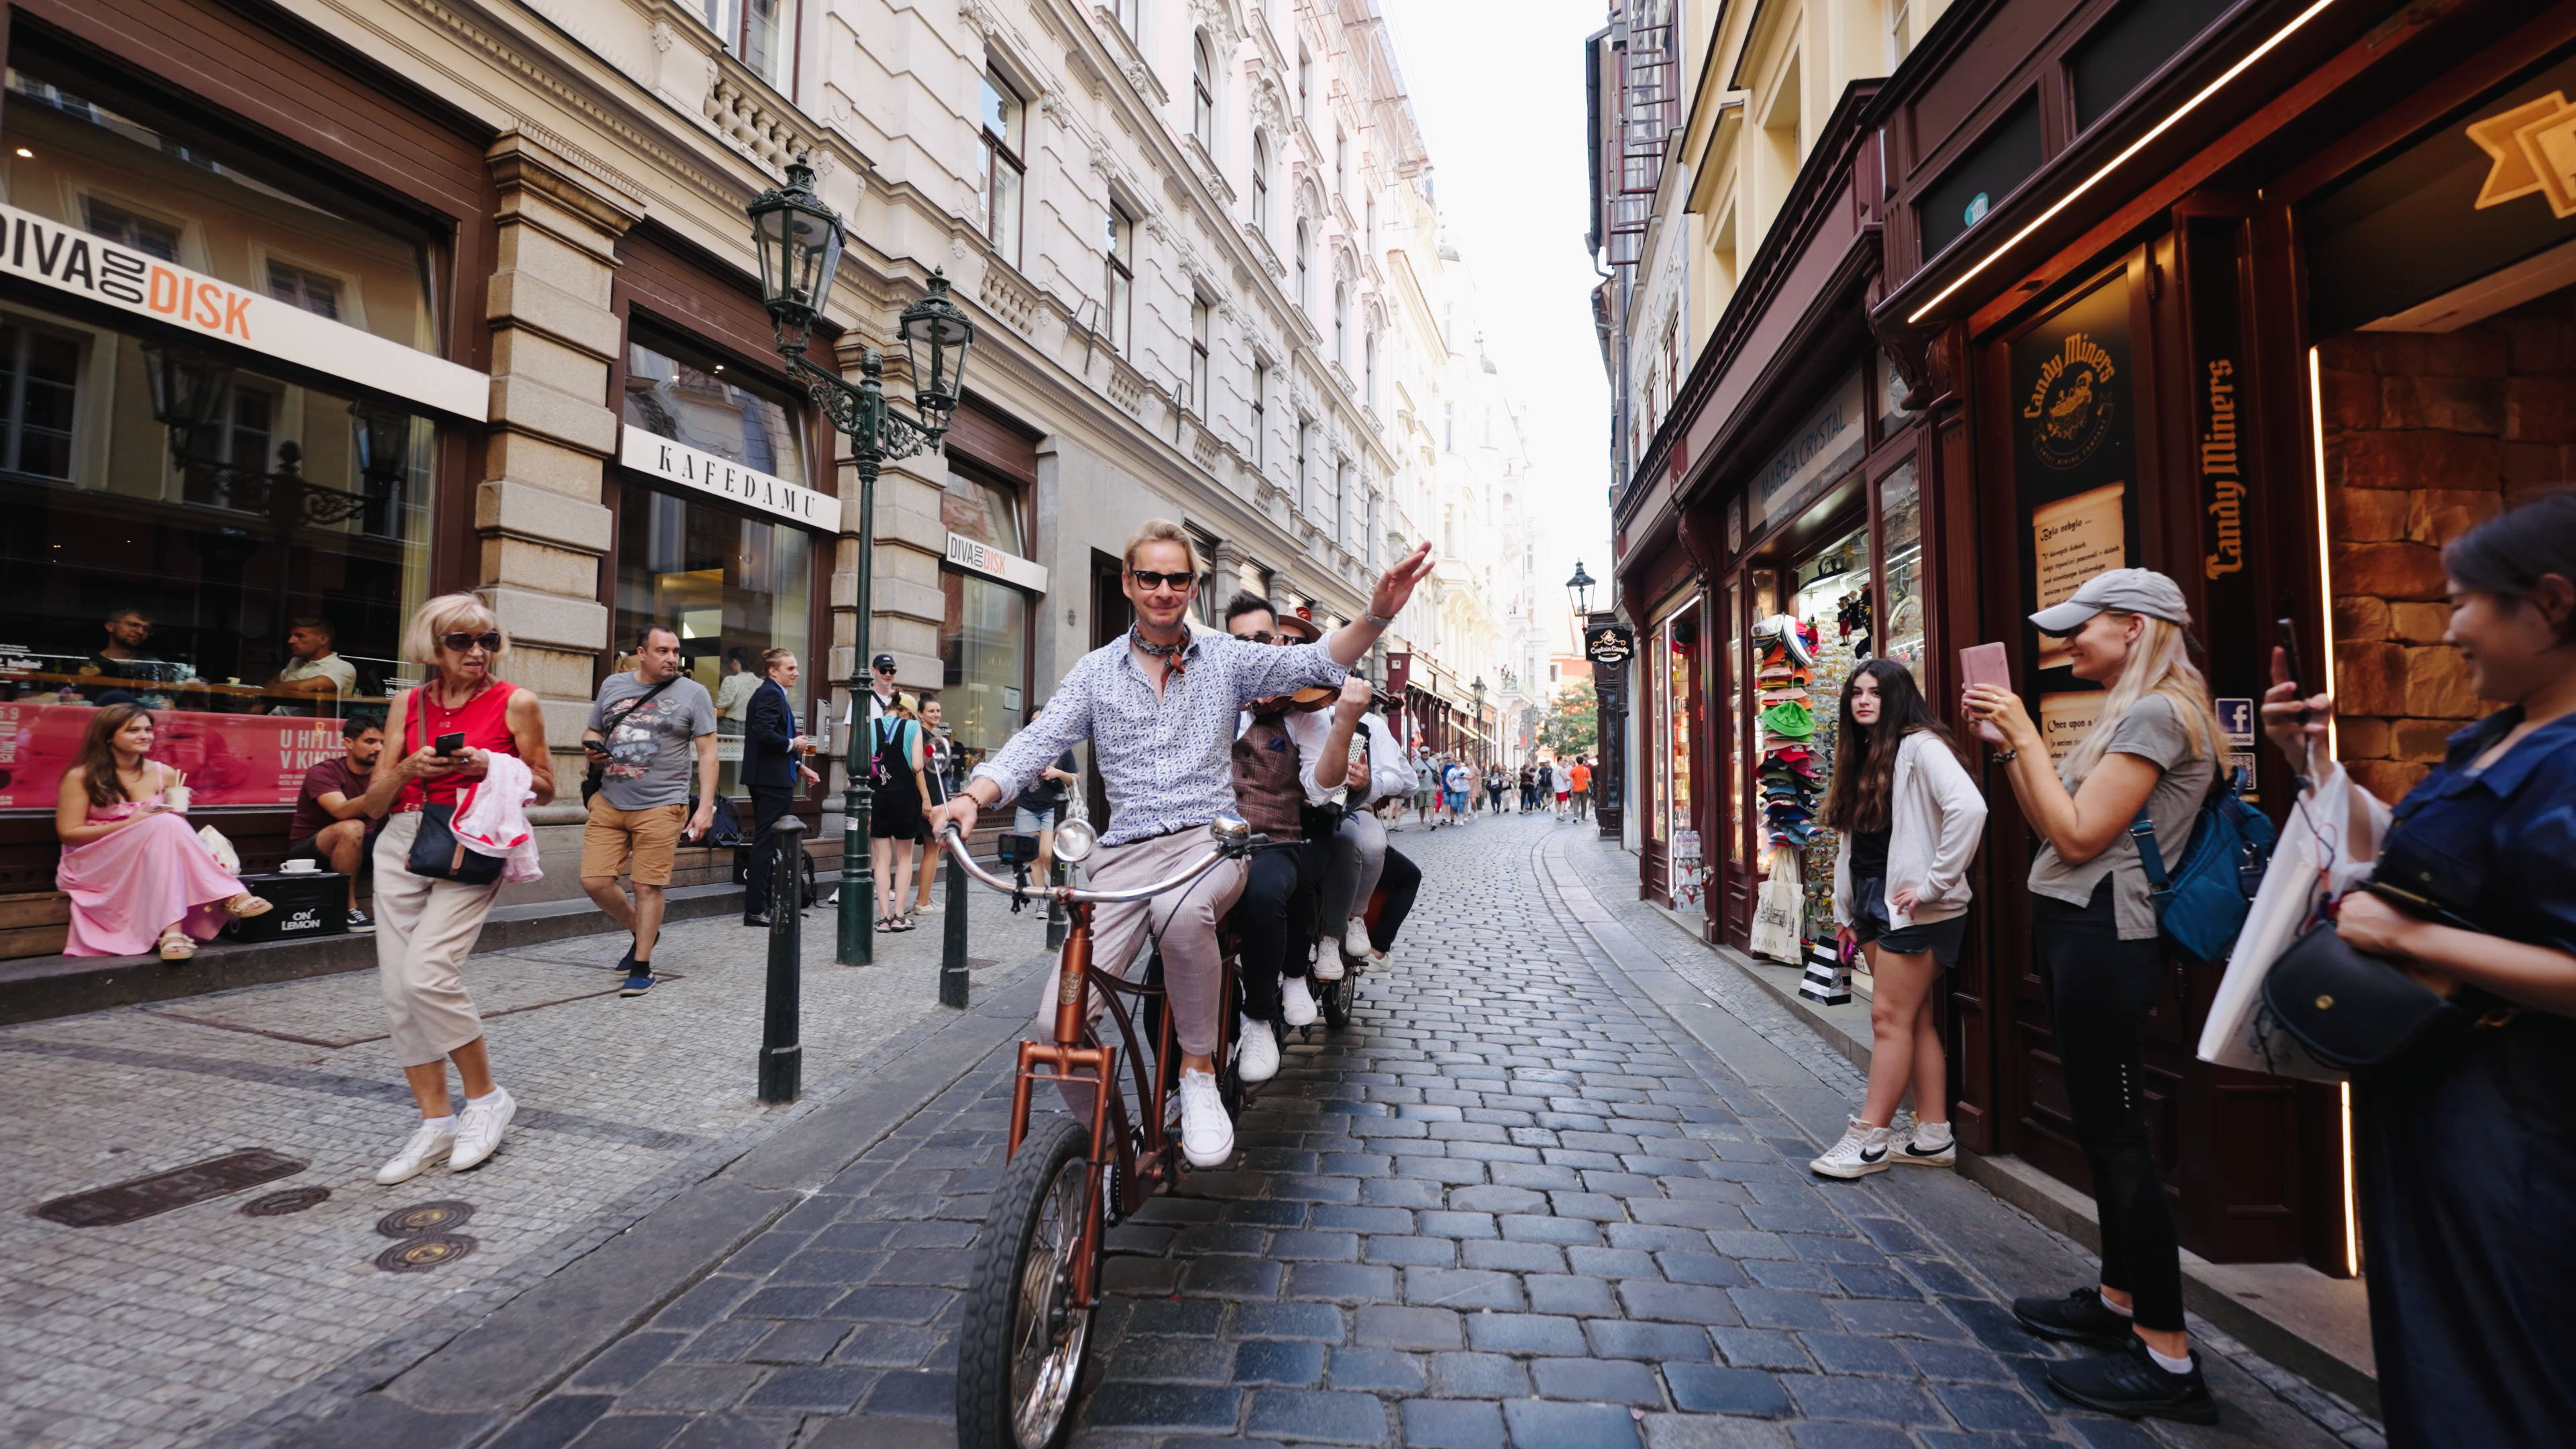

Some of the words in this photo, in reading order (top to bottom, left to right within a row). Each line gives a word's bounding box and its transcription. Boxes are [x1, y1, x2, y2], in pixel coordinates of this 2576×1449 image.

[0, 213, 94, 290] IVA
[148, 265, 252, 341] DISK
[2023, 354, 2063, 419] Candy
[2063, 332, 2115, 384] Miners
[2201, 359, 2239, 476] Miners
[1761, 445, 1799, 504] MAREA
[1799, 403, 1847, 468] CRYSTAL
[2040, 526, 2059, 541] Bylo
[2060, 518, 2082, 533] nebylo
[2205, 480, 2247, 580] Candy
[950, 536, 973, 566] DIVA
[983, 548, 1006, 576] DISK
[1611, 645, 1629, 655] Candy
[2047, 719, 2067, 733] Once
[2069, 720, 2086, 731] upon
[280, 729, 292, 748] U
[298, 729, 347, 749] HITLE
[280, 750, 292, 769] V
[281, 919, 321, 931] LEMON
[292, 910, 313, 921] ON
